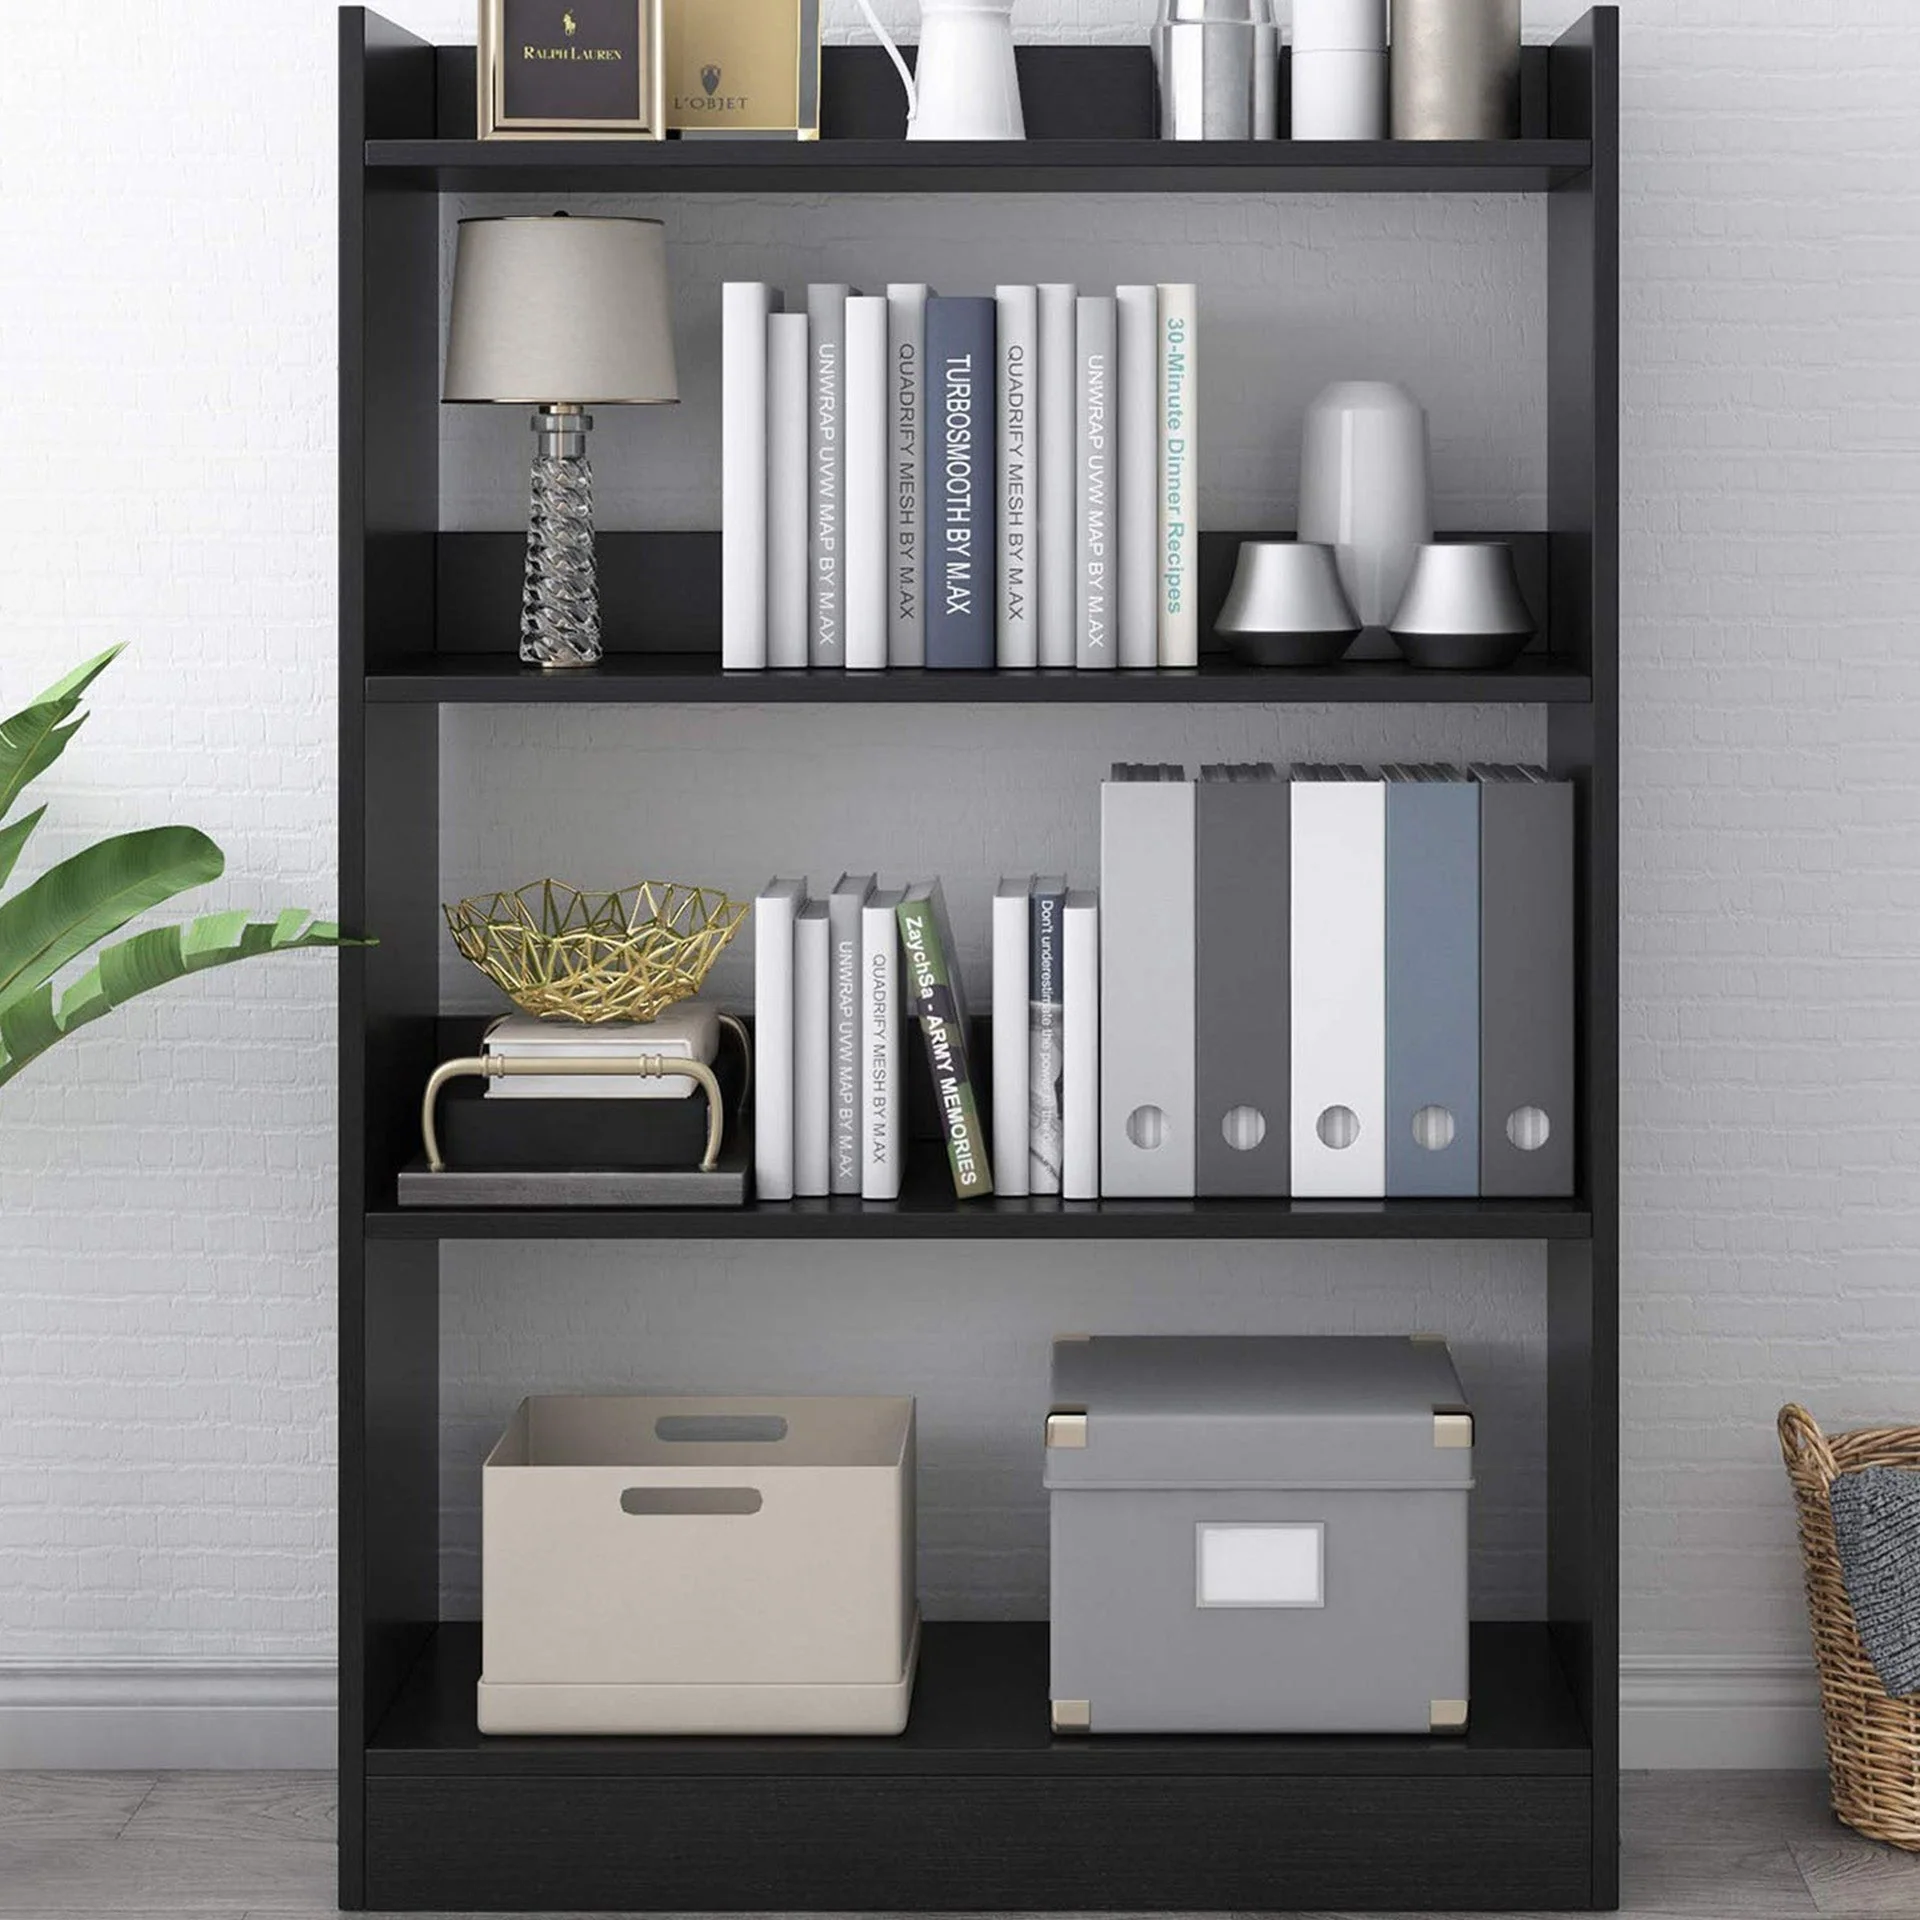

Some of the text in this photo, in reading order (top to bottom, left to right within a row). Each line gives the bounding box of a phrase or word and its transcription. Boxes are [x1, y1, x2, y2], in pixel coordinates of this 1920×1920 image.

[819, 343, 835, 645] UNWRAP UVW MAP BY M.AX
[898, 343, 915, 619] QUADRIFY MESH BY M.AX
[946, 354, 971, 614] TURBOSMOOTH BY M.AX
[1008, 345, 1024, 620] QUADRIFY MESH BY M.AX
[1088, 355, 1104, 647] UNWRAP UVW MAP BY M.AX
[1164, 318, 1185, 614] 30-Minute Dinner Recipes
[905, 916, 935, 998] ZaychSa
[927, 1015, 953, 1072] ARMY
[940, 1079, 977, 1185] MEMORIES
[1041, 900, 1053, 933] Don't
[1041, 936, 1054, 1026] underestimate
[839, 941, 852, 1177] UNWRAP UVW MAP BY M.AX
[872, 954, 886, 1163] QUADRIFY MESH BY M.AX
